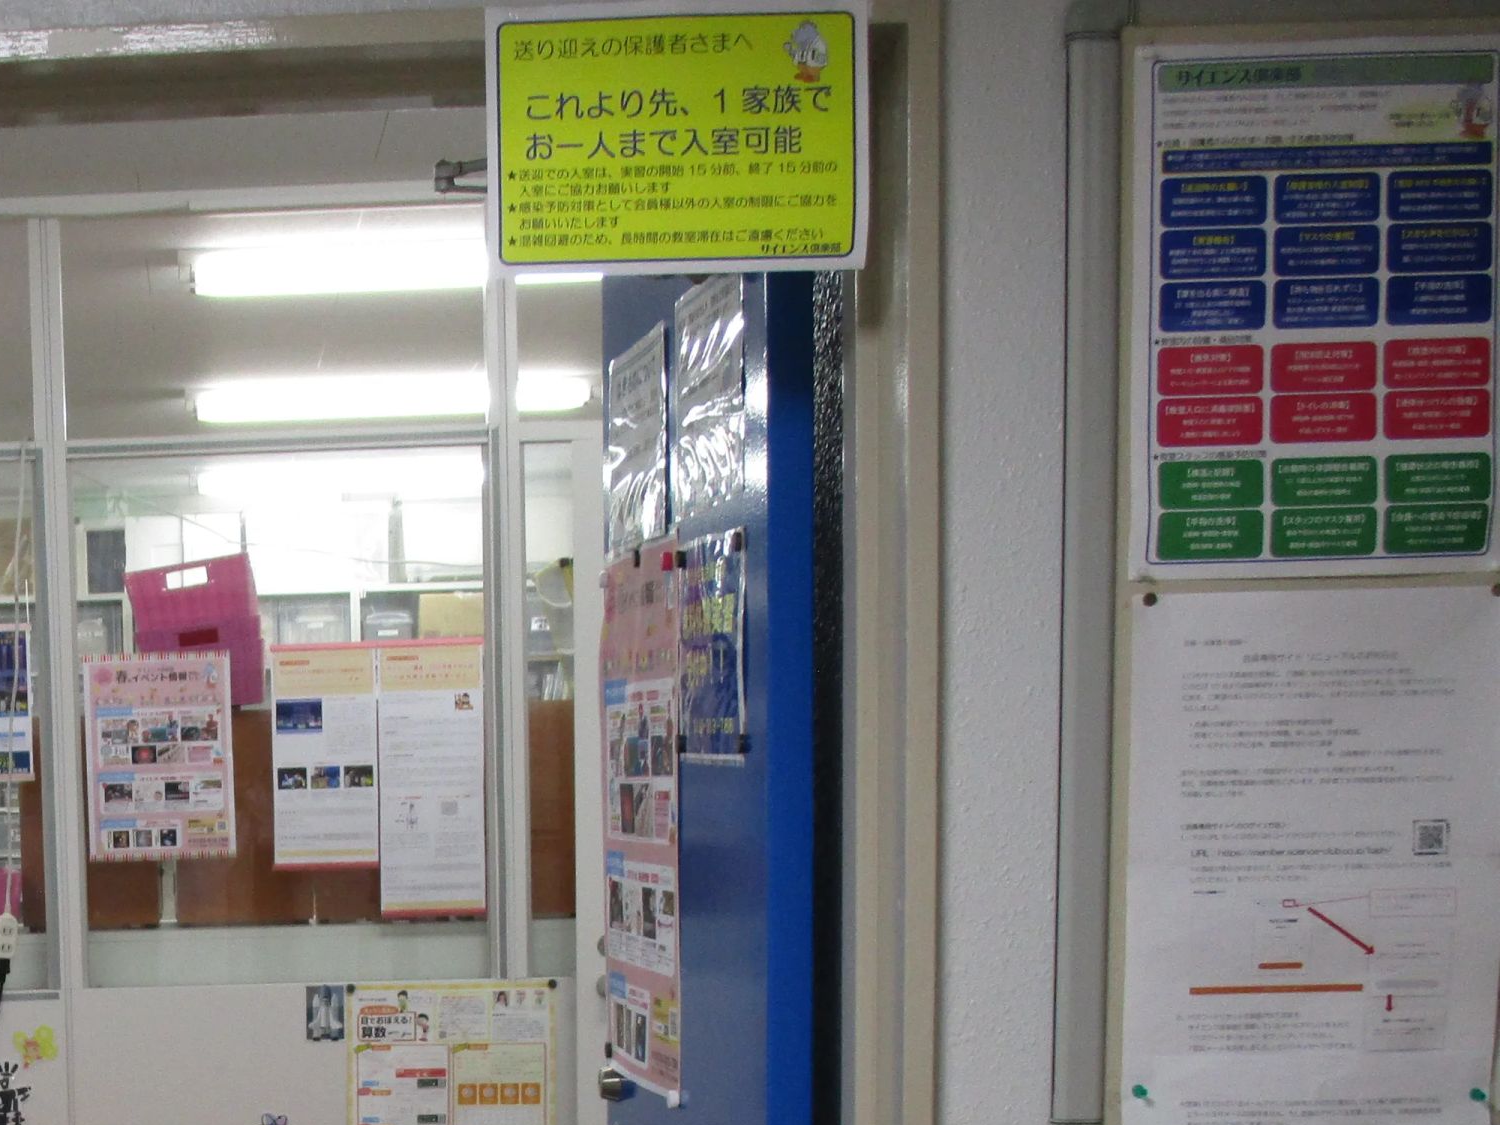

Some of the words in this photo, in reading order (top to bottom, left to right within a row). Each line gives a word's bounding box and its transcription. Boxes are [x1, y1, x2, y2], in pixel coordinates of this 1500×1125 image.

[513, 33, 754, 62] 送り迎えの保護者さまへ
[525, 125, 803, 161] お一人まで入室可能
